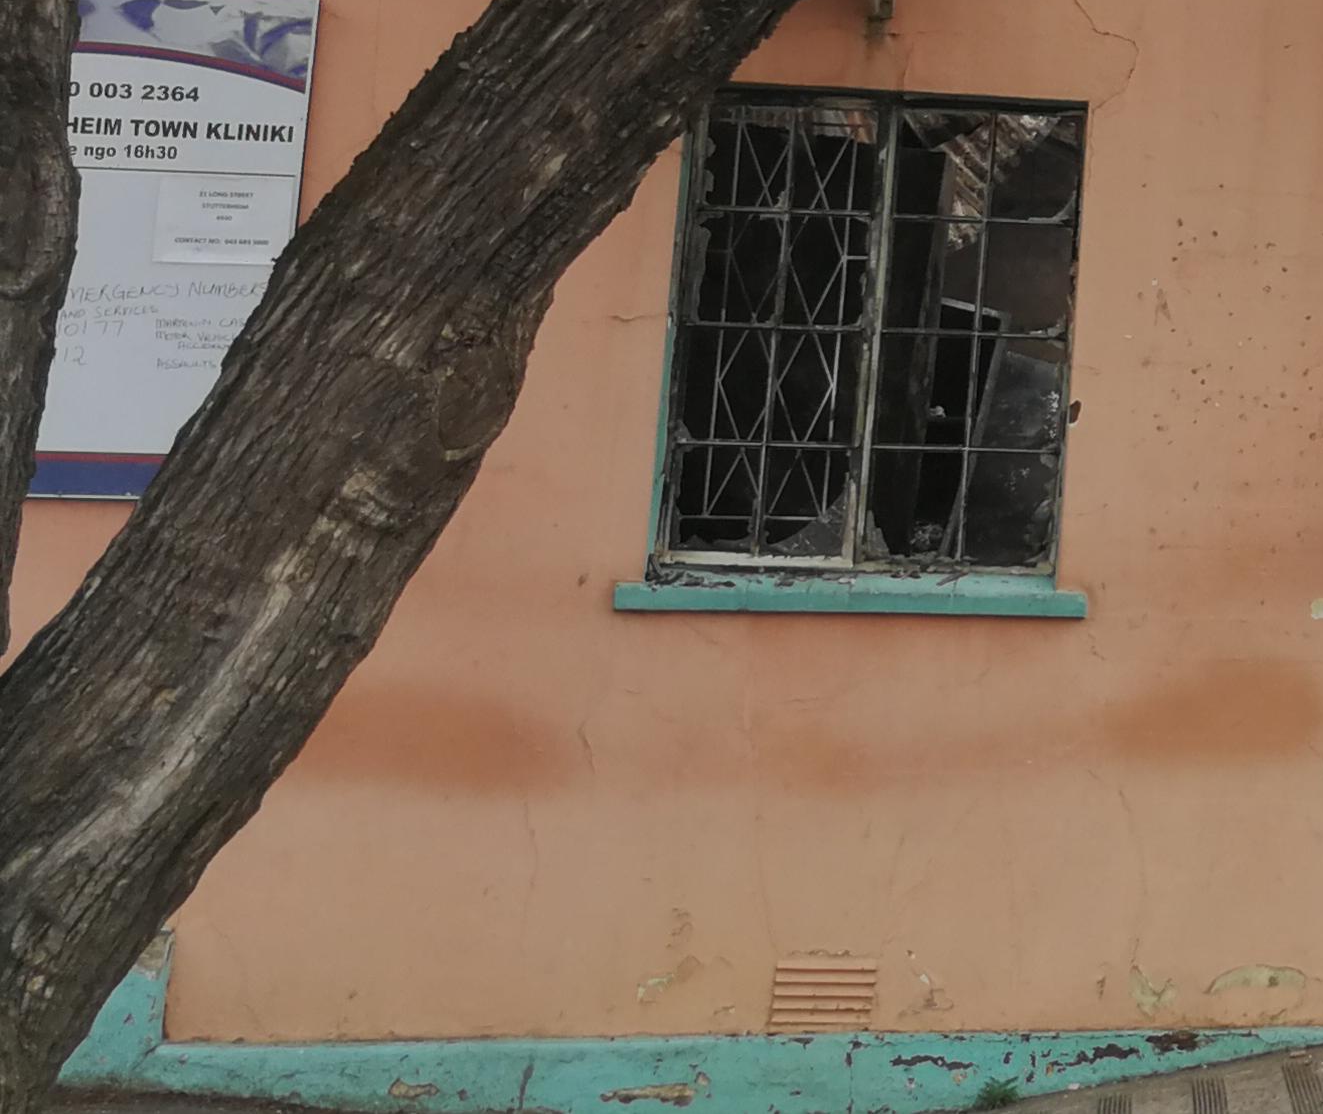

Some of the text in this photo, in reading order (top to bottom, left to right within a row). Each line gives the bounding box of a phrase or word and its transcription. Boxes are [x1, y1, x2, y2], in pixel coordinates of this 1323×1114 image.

[89, 82, 132, 99] 003
[141, 84, 200, 102] 2364
[131, 119, 198, 139] TOWN
[206, 123, 294, 143] KLINIKI
[84, 146, 117, 160] ngo
[124, 144, 178, 160] 16h30
